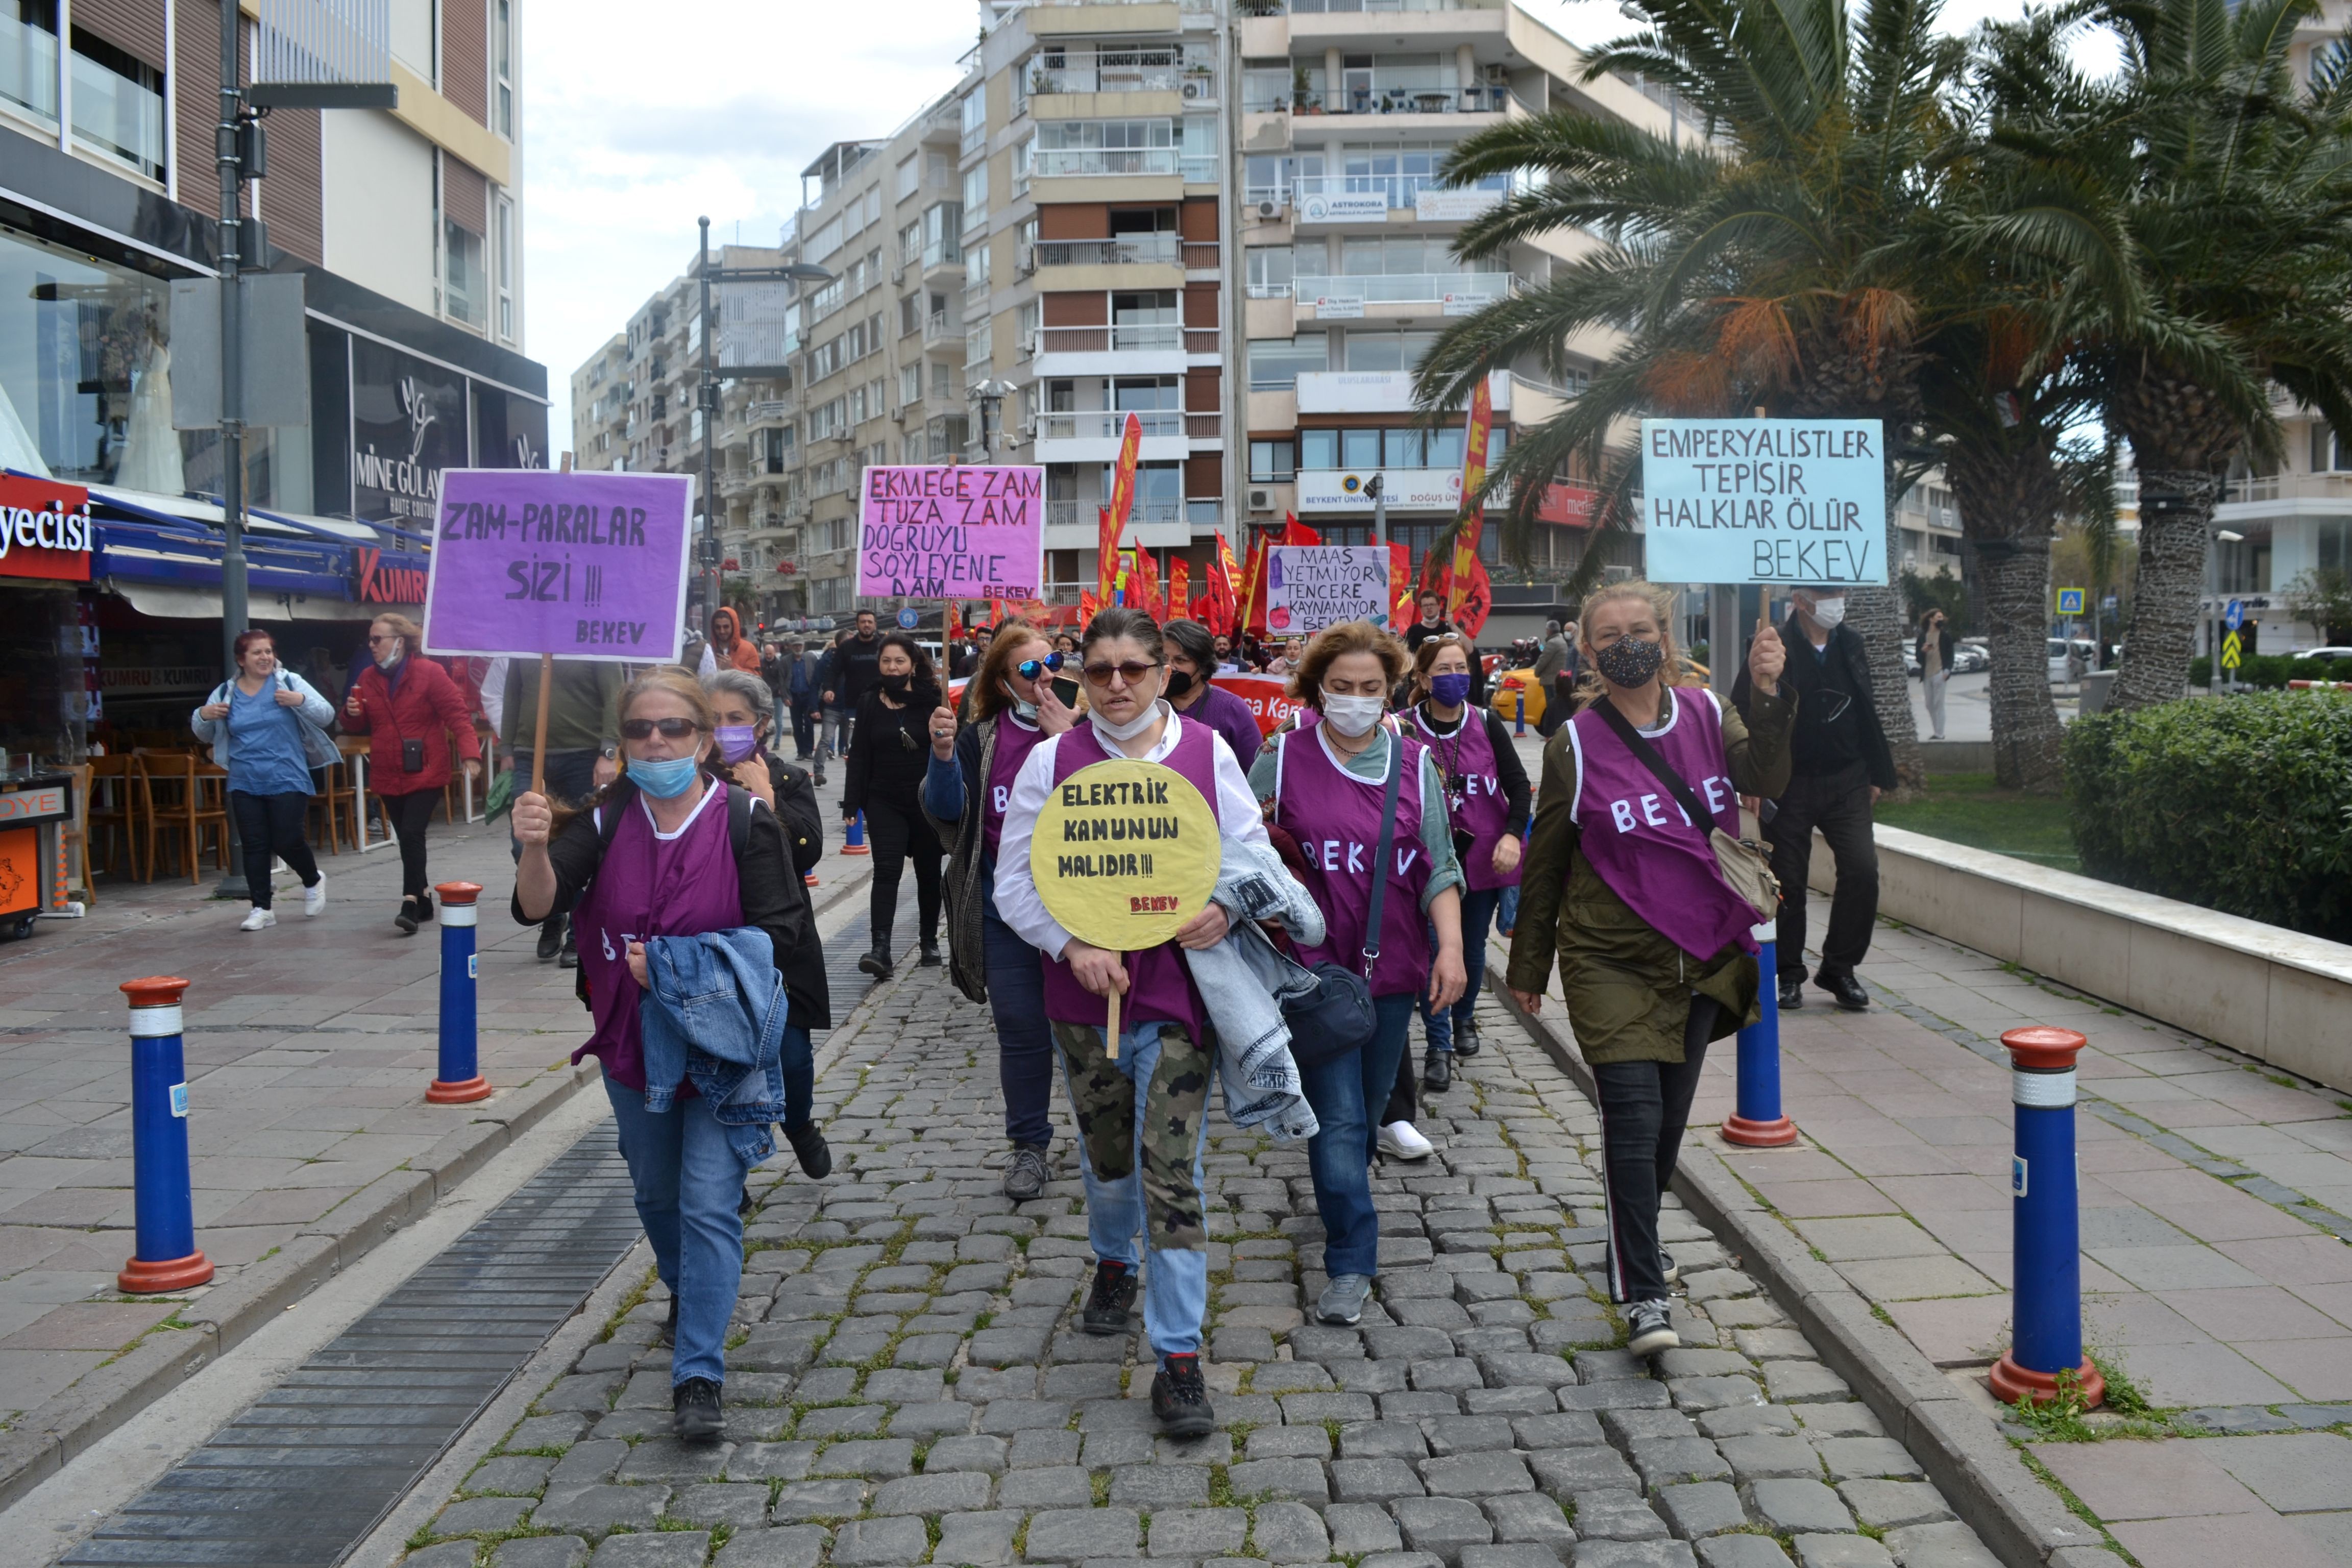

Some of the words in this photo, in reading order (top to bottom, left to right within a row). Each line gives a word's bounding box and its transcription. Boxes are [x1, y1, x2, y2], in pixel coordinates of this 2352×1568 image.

[1331, 201, 1383, 209] ASTROKORA
[1338, 376, 1391, 385] ULUSLARARASI
[1652, 428, 1874, 458] EMPERYALİSTLER
[356, 443, 396, 492] MİNE
[1692, 460, 1807, 496] TEPİŞİR
[870, 468, 973, 498] EKMEĞE
[982, 471, 1042, 499] ZAM
[389, 497, 410, 516] HAUTE
[1306, 496, 1342, 504] BEYKENT
[1411, 492, 1442, 503] DOĞUŞ
[440, 502, 647, 547] ZAM-PARALAR
[873, 498, 944, 525] TUZA
[957, 498, 1027, 526] ZAM
[1654, 498, 1777, 530] HALKLAR
[1787, 497, 1864, 532] ÖLÜR
[863, 524, 967, 553] DOĞRUYU
[865, 551, 1006, 582] SÖYLEYENE
[1301, 548, 1353, 566] MAAŞ
[1754, 539, 1870, 581] BEKEV
[358, 546, 430, 603] KUMR
[505, 552, 571, 602] SİZİ
[983, 584, 1036, 599] BEKEV
[1283, 583, 1362, 599] TENCERE
[1289, 600, 1379, 616] KAYNAMIYOR
[575, 619, 647, 645] BEKEV
[163, 668, 212, 686] KUMRU
[1266, 696, 1304, 719] Kar
[1062, 777, 1169, 807] ELEKTRİK
[1063, 816, 1179, 842] KAMUNUN
[1302, 840, 1417, 876] BEKV
[1130, 896, 1179, 912] BEKEV
